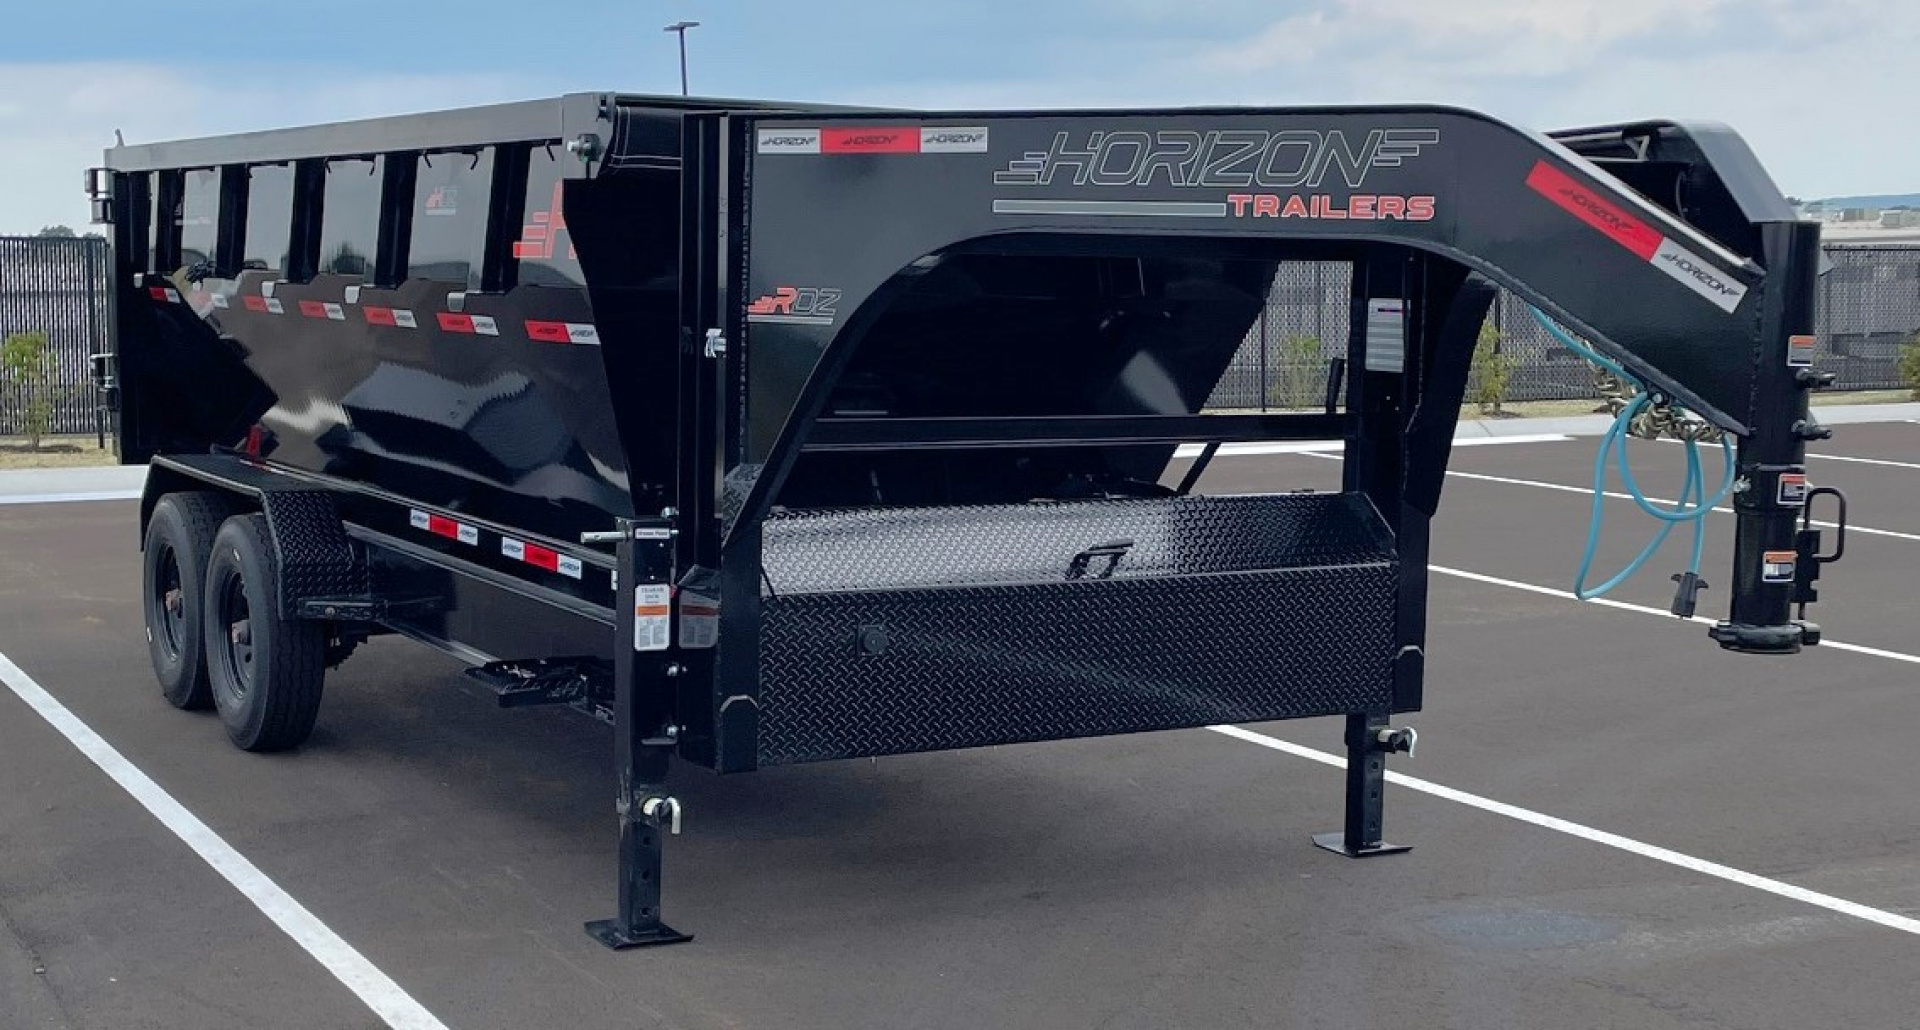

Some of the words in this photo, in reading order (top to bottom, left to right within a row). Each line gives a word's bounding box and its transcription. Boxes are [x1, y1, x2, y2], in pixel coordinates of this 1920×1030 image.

[766, 136, 813, 147] HORIZON
[930, 133, 978, 145] HORIZON
[1039, 129, 1385, 187] HORIZON
[1227, 194, 1435, 220] TRAILERS
[1670, 252, 1731, 296] HORIZON
